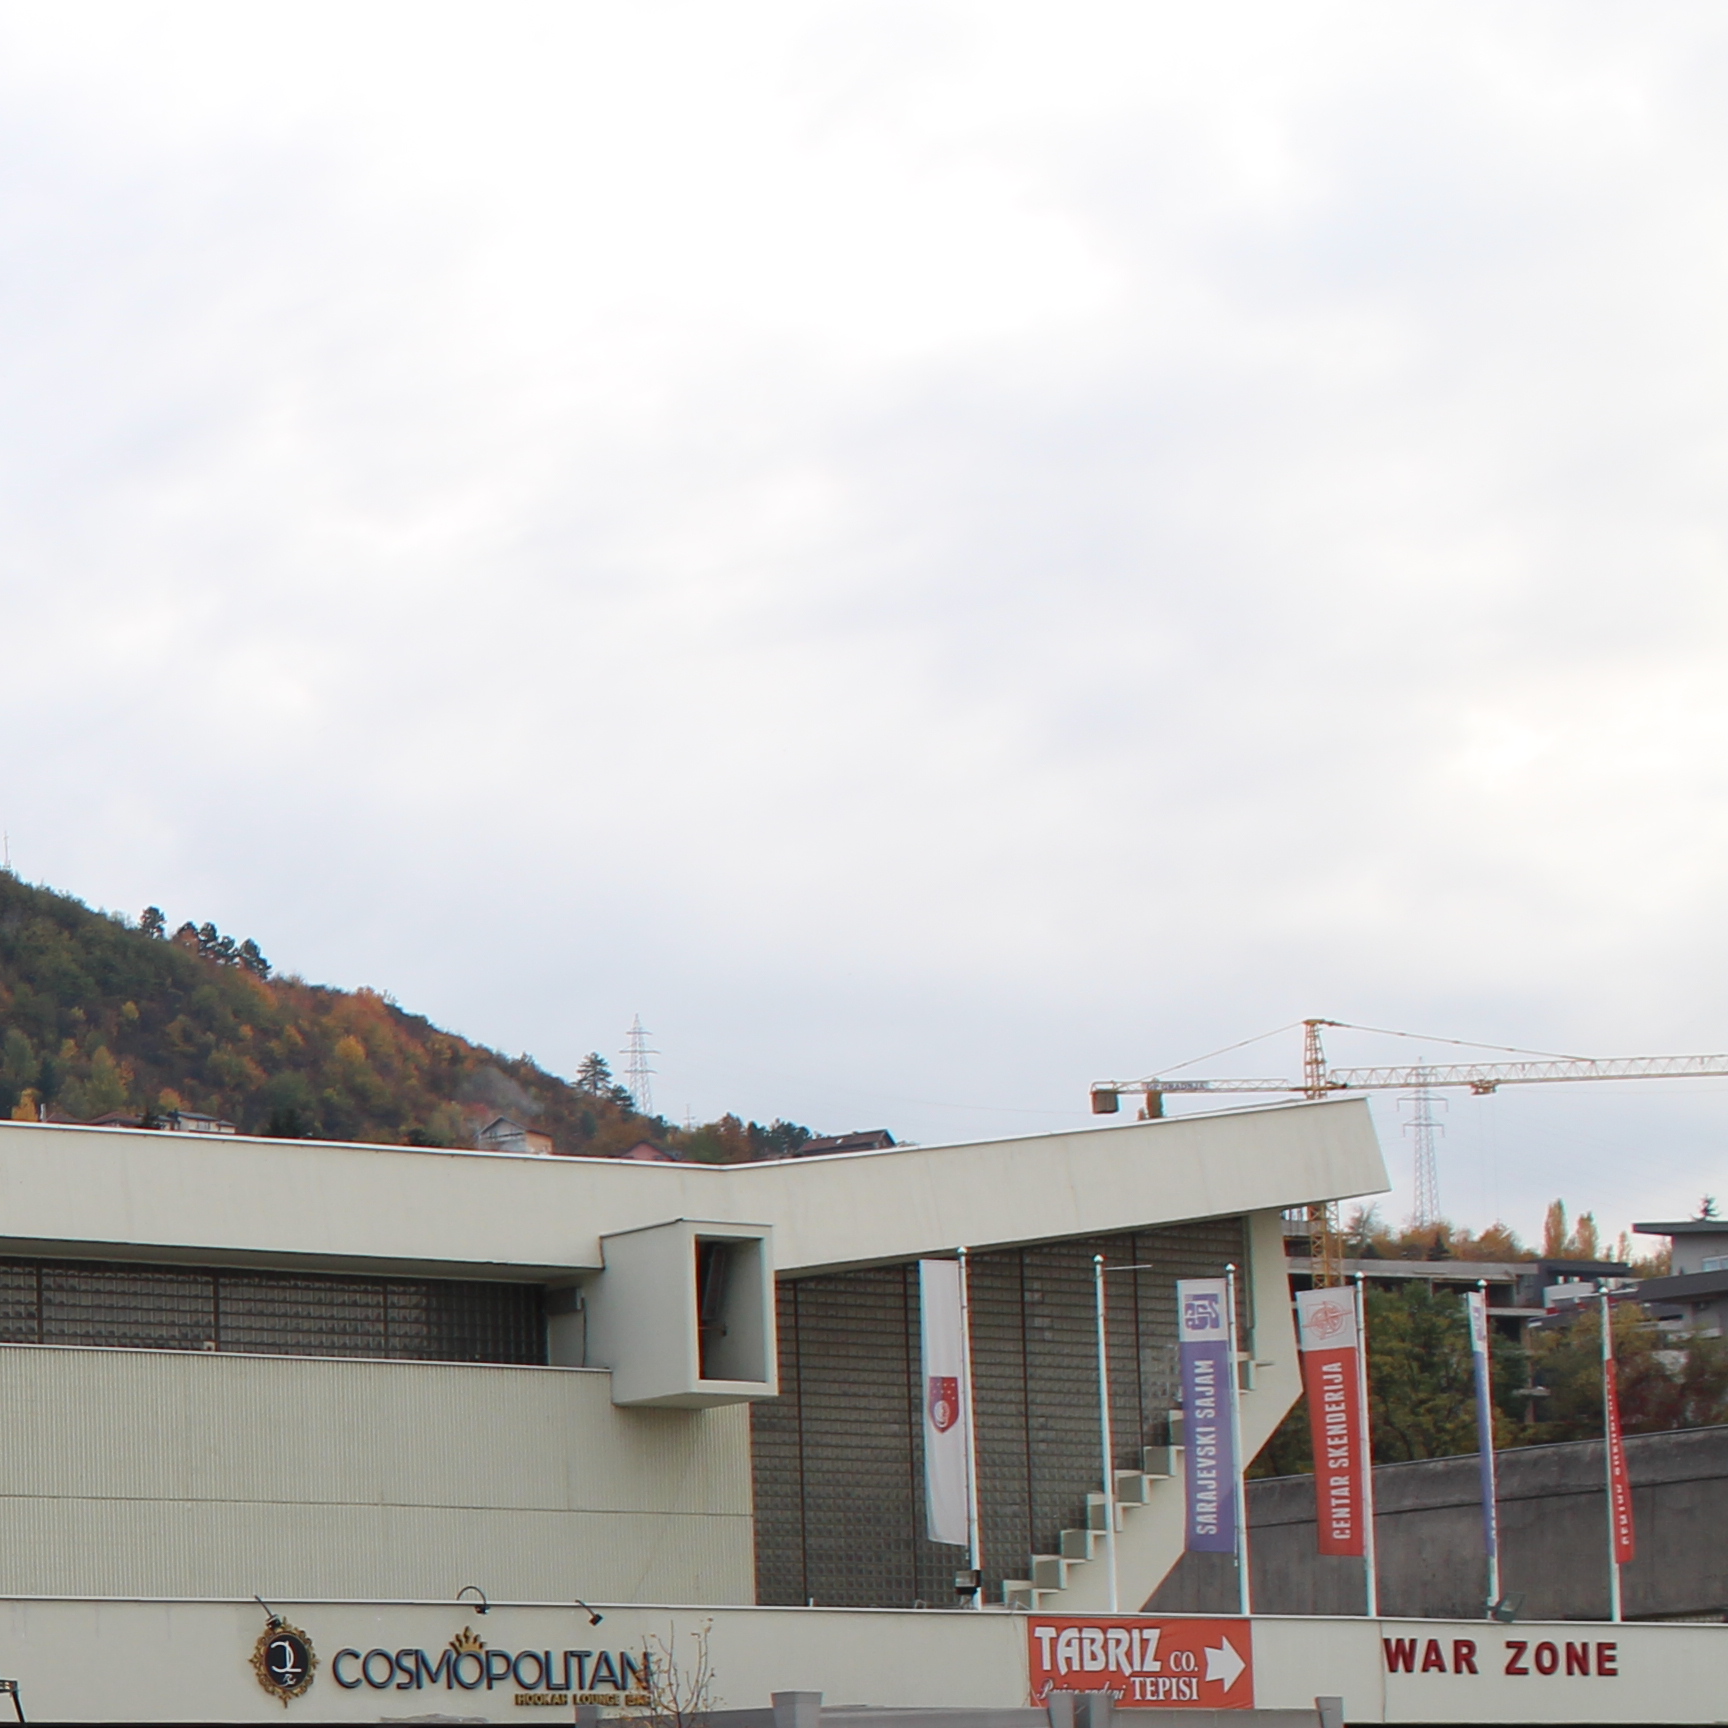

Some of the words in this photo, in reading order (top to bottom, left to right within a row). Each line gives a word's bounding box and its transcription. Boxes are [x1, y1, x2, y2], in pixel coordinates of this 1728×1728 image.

[1193, 1358, 1216, 1420] SAJAM
[1321, 1361, 1350, 1468] SKENDERIJA
[1195, 1426, 1218, 1535] SARAJEVSKI
[1329, 1474, 1351, 1540] CENTAR
[331, 1647, 652, 1691] COSMOPOLITAN
[1034, 1626, 1162, 1677] TABRIZ
[1169, 1651, 1199, 1672] CO.
[1383, 1637, 1479, 1675] WAR
[1504, 1640, 1619, 1676] ZONE
[514, 1693, 568, 1706] HOOKAH
[572, 1693, 621, 1706] LOUNGE
[1130, 1676, 1199, 1701] TEPISI
